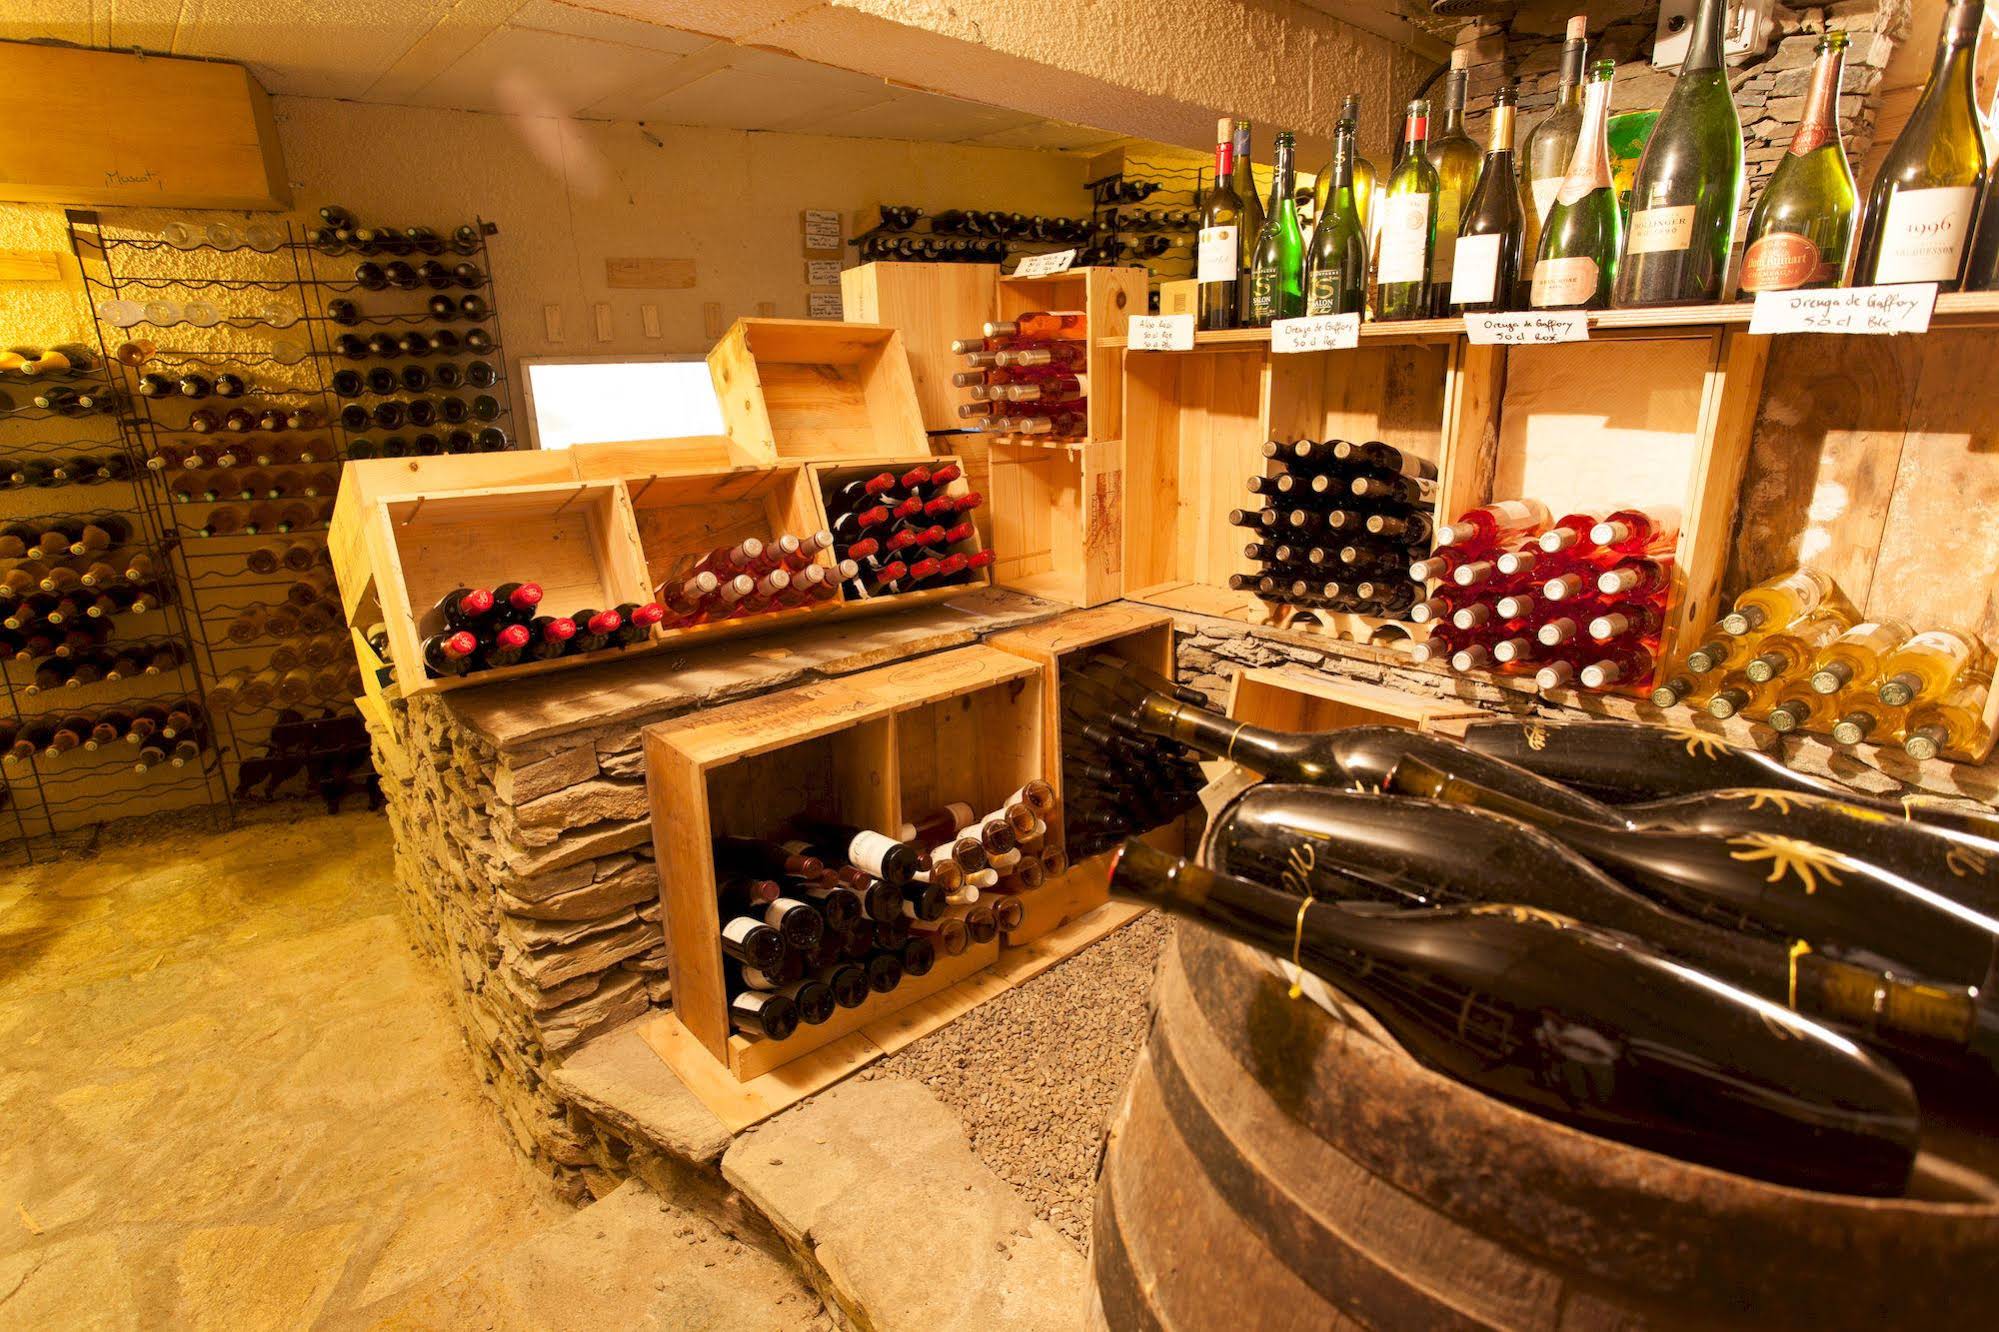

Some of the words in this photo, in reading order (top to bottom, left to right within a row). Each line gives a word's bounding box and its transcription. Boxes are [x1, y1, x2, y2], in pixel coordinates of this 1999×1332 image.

[104, 169, 162, 187] Muscat
[1908, 212, 1956, 239] 1996
[1845, 293, 1861, 307] de
